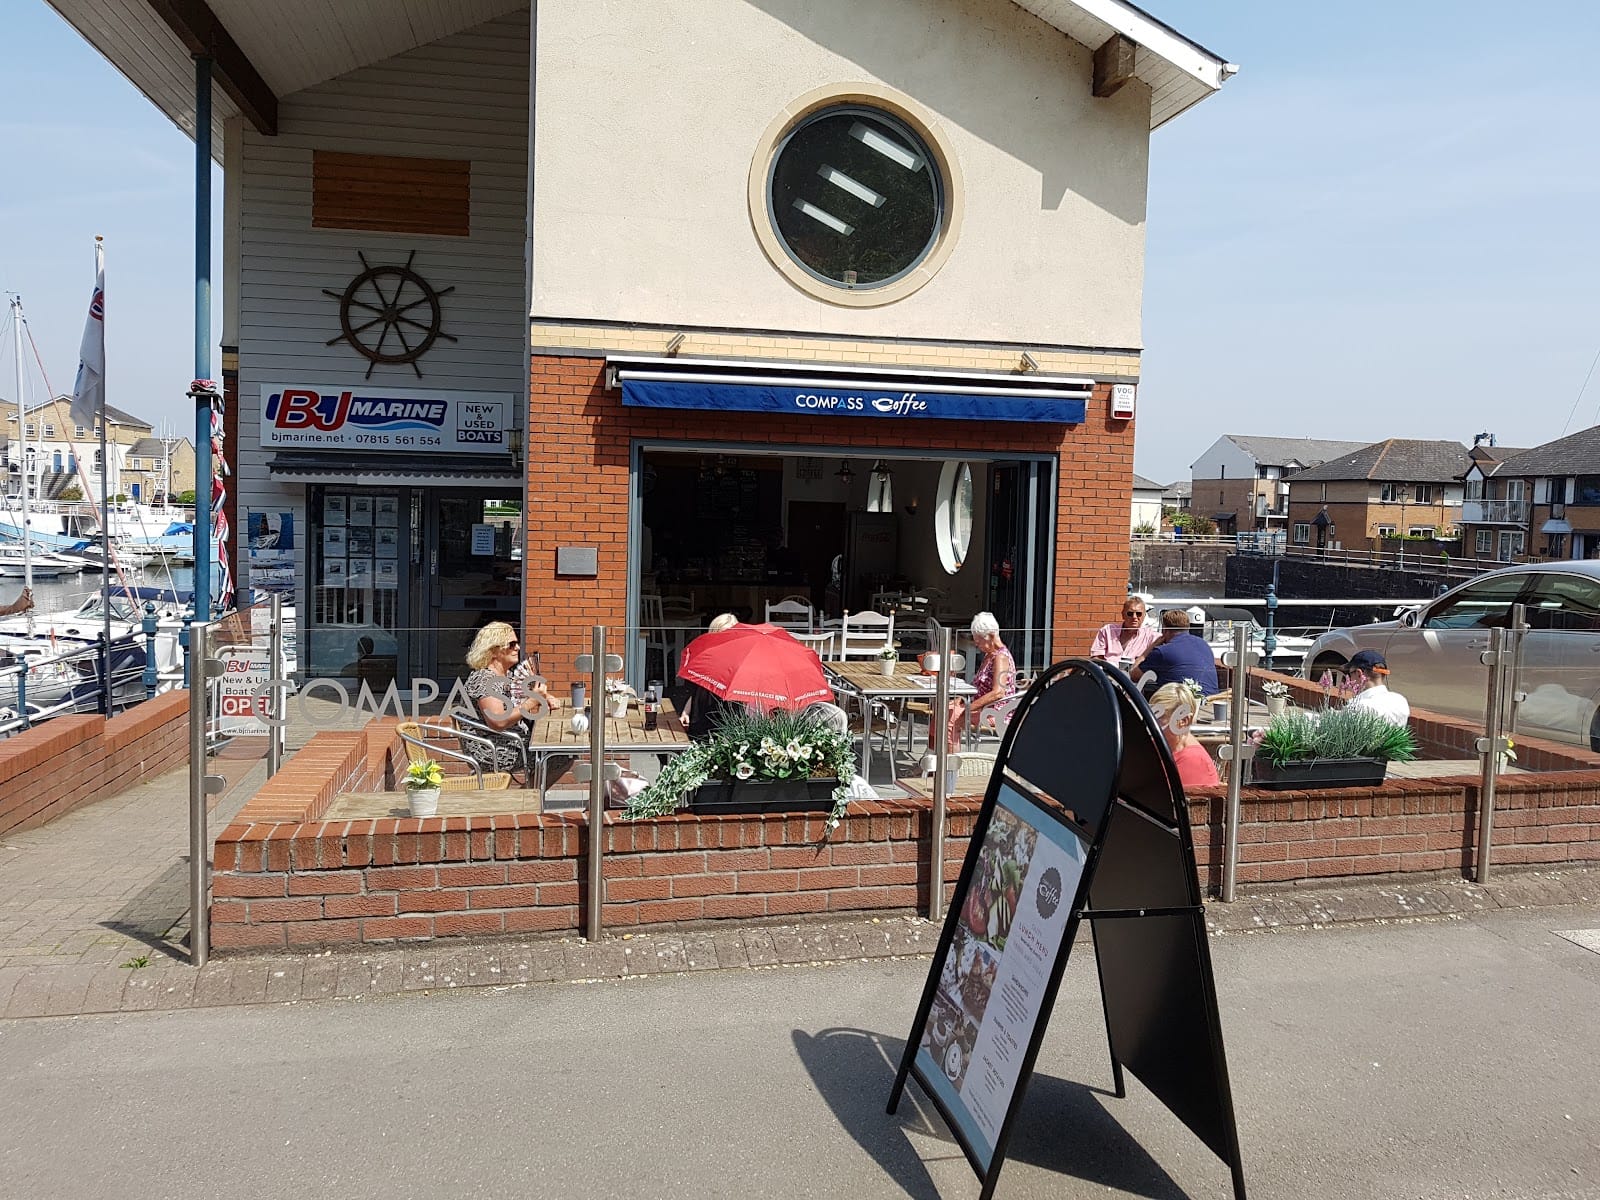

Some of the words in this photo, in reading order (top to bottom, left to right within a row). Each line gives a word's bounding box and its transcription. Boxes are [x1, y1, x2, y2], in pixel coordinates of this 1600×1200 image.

[465, 405, 495, 414] NEW
[795, 394, 864, 410] COMPASS
[871, 392, 928, 415] Coffee
[275, 389, 352, 432] BJ
[351, 401, 445, 419] MARINE
[464, 420, 495, 429] USED
[271, 432, 345, 444] bjmarine.net
[355, 434, 390, 444] 07815
[395, 435, 415, 445] 561
[419, 436, 441, 446] 554
[459, 430, 501, 442] BOATS
[1194, 613, 1201, 622] C
[226, 660, 251, 673] BJ
[222, 676, 243, 684] New
[245, 676, 252, 684] &
[225, 687, 248, 696] Boat
[223, 698, 271, 715] OPE
[251, 677, 550, 727] COMPASS
